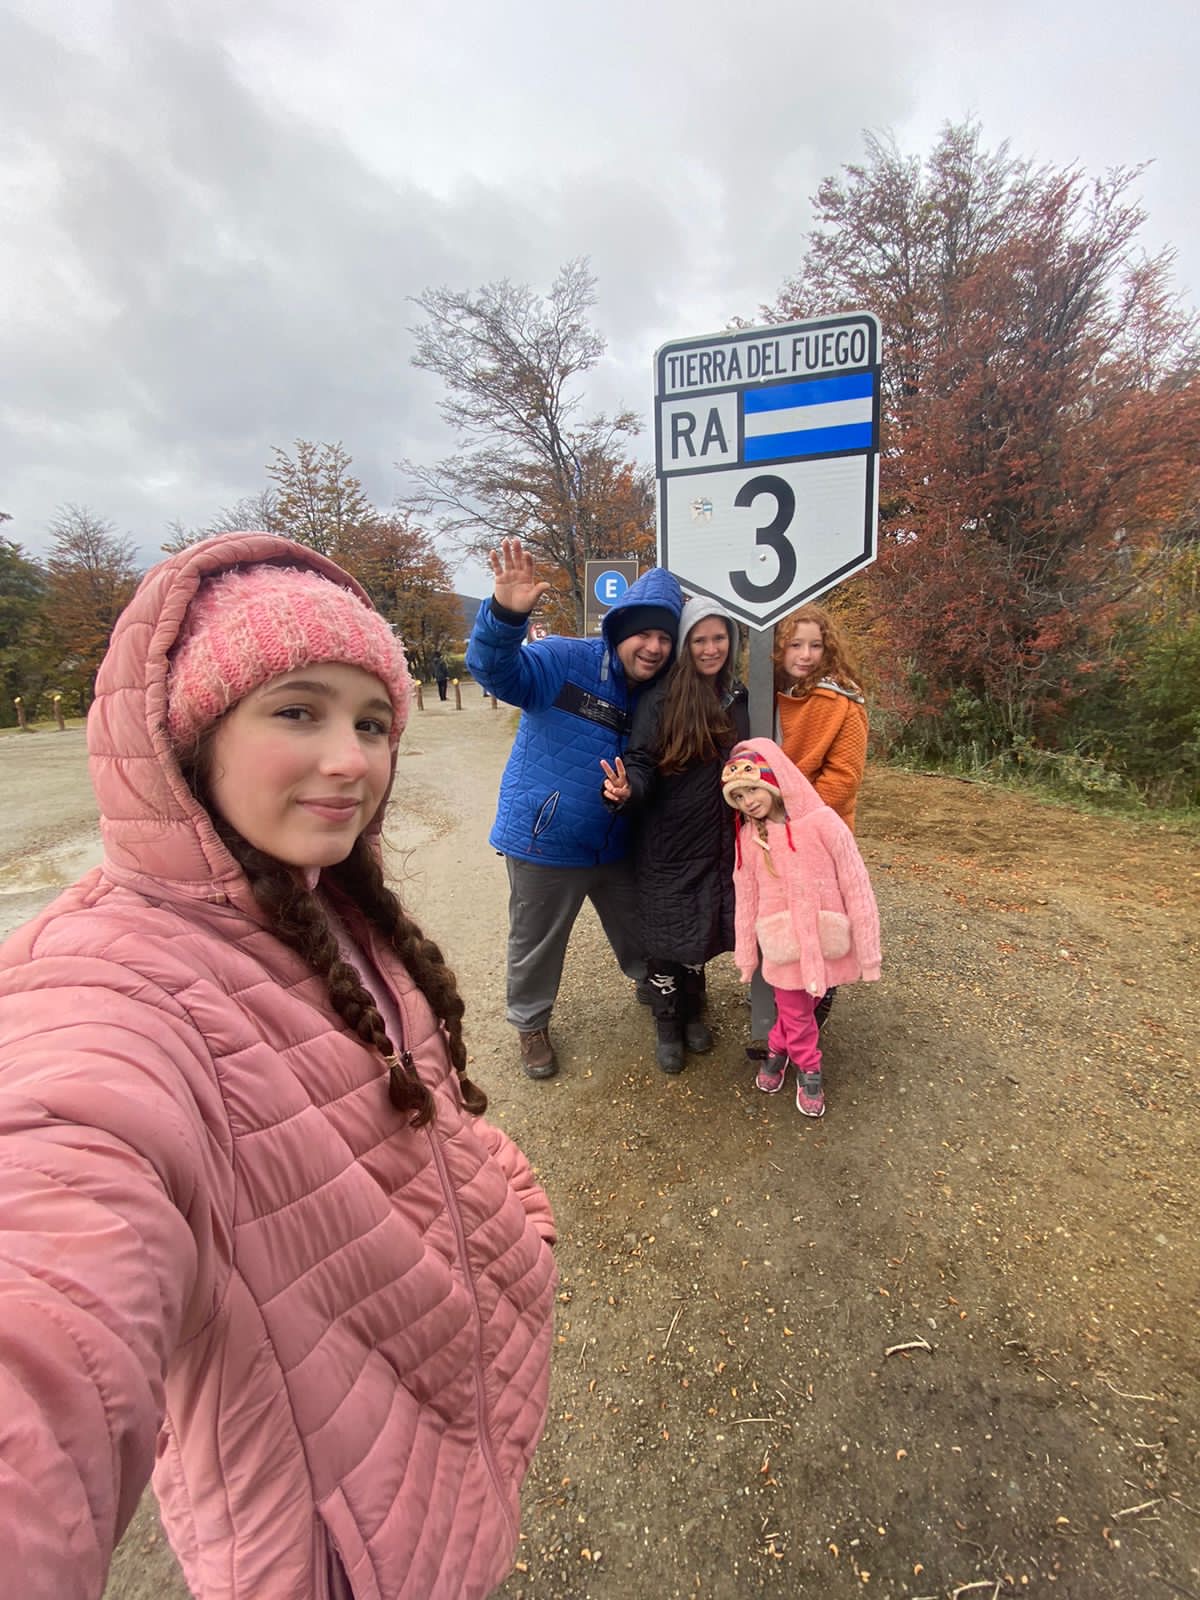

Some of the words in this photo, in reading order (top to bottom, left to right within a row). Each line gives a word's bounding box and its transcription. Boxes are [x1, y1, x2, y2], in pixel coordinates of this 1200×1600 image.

[667, 347, 743, 389] TIERRA
[747, 341, 787, 378] DEL
[791, 328, 867, 372] FUEGO
[671, 407, 729, 460] RA
[729, 474, 797, 604] 3
[605, 579, 618, 599] E
